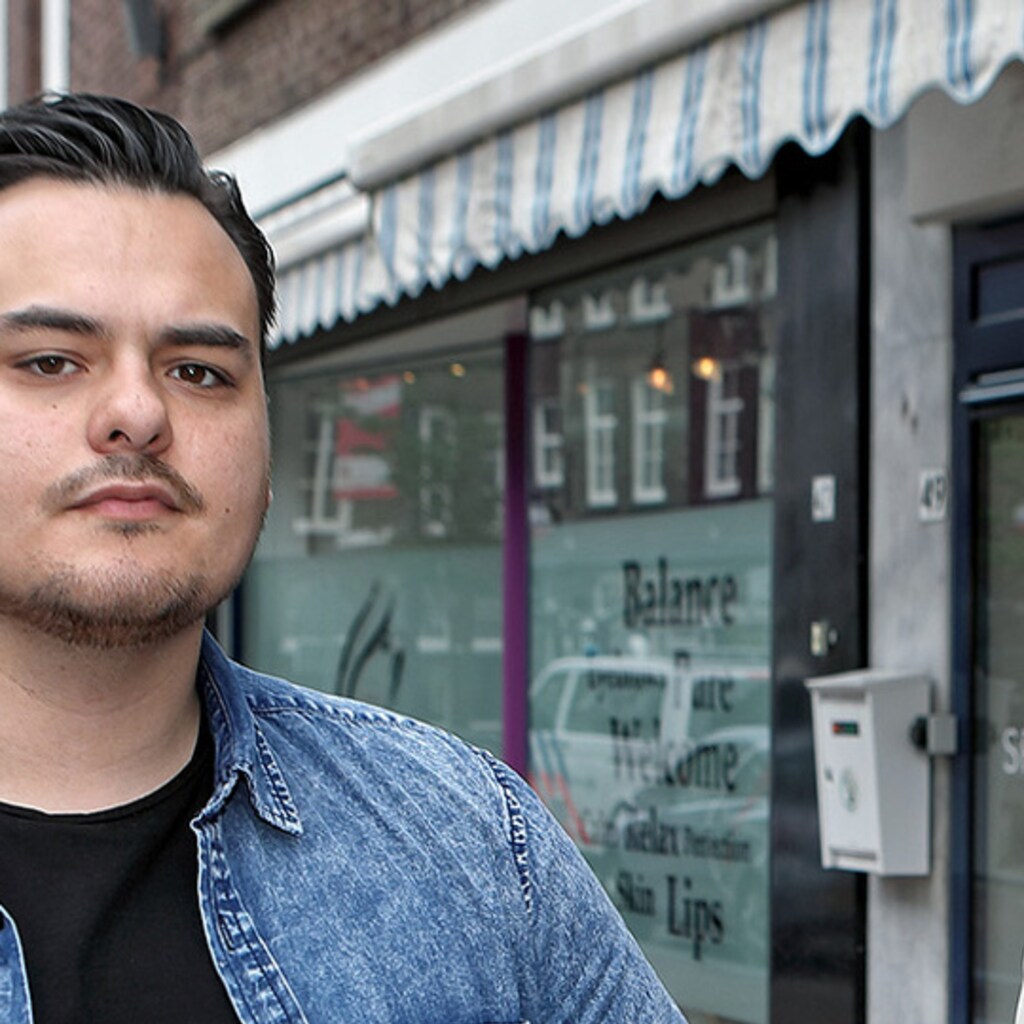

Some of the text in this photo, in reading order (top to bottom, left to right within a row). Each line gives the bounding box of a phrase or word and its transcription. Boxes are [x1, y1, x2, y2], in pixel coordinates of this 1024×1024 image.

[622, 557, 739, 628] Balance
[609, 717, 739, 793] Welcome
[666, 874, 724, 961] Lips
